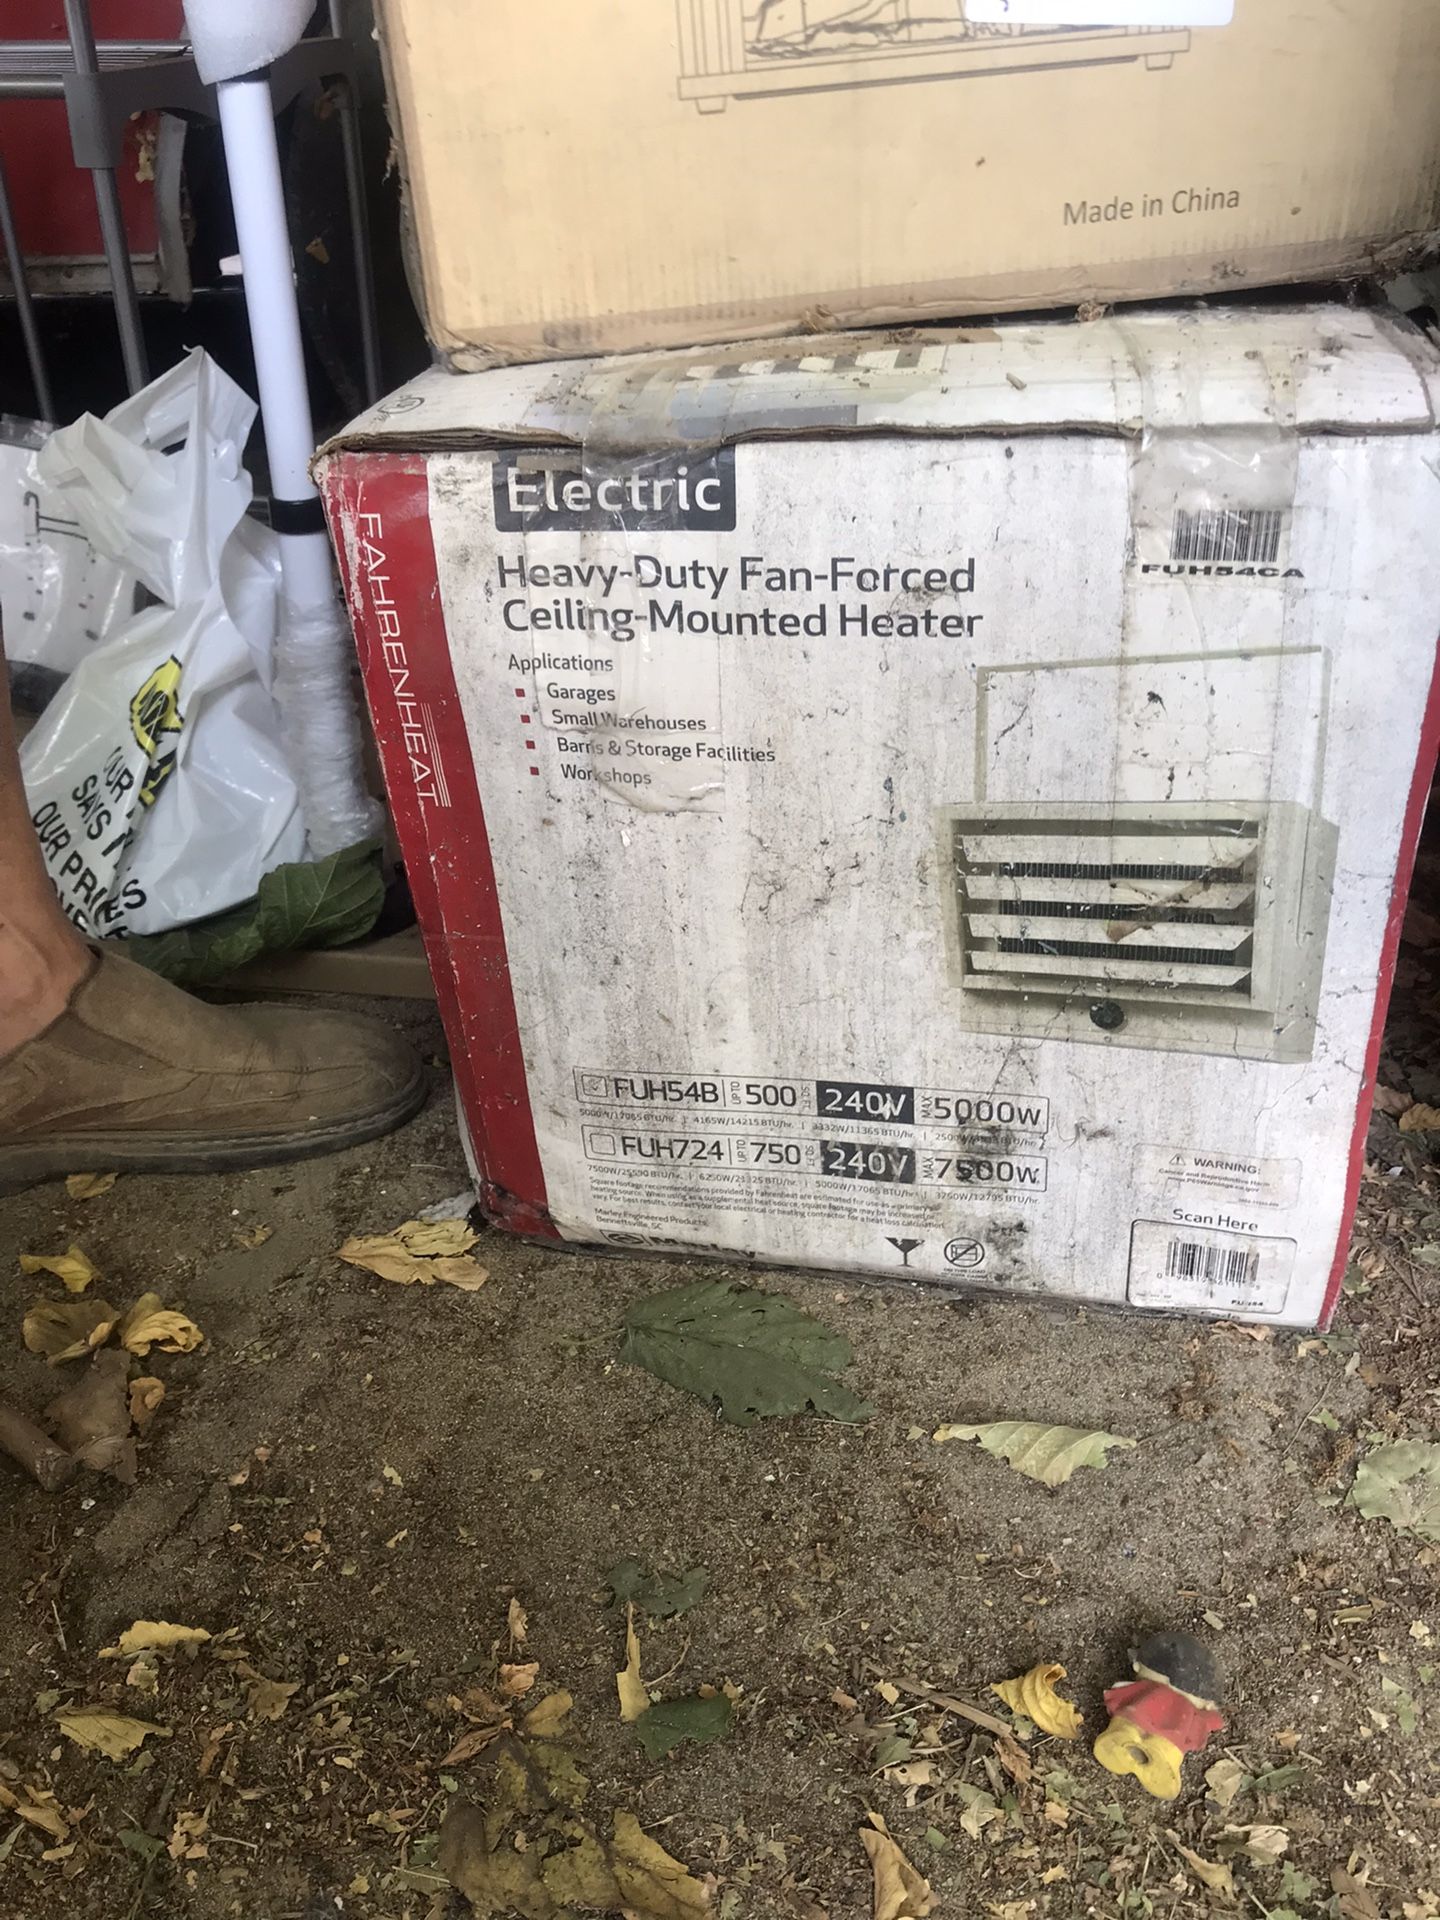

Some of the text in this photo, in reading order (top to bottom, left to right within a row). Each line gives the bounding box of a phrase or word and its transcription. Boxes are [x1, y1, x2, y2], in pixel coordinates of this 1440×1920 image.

[1063, 187, 1240, 226] Made in China
[507, 466, 721, 512] Electric
[497, 555, 975, 600] Heavy-Duty Fan-Forced
[1141, 564, 1305, 578] FUH54CA
[502, 599, 983, 642] Ceiling-Mounted Heater
[359, 512, 438, 807] FAHRENHEAT
[508, 653, 614, 674] Applications
[546, 682, 616, 704] Garages
[551, 709, 707, 731] Small Warehouses
[608, 740, 622, 756] &
[625, 740, 691, 762] Storage
[695, 742, 776, 762] Facilities
[71, 774, 112, 841] SAYS
[32, 801, 72, 862] OUR
[613, 1077, 719, 1103] FUH54B
[745, 1083, 798, 1108] 500
[824, 1088, 906, 1120] 240V
[920, 1096, 933, 1118] MAX
[934, 1097, 1041, 1126] 5000W
[621, 1136, 724, 1161] FUH724
[750, 1142, 801, 1165] 750
[828, 1148, 908, 1175] 240V
[922, 1156, 934, 1179] MAX
[935, 1157, 1040, 1184] 7500W
[1193, 1157, 1261, 1175] WARNING:
[1172, 1208, 1259, 1232] Scan Here
